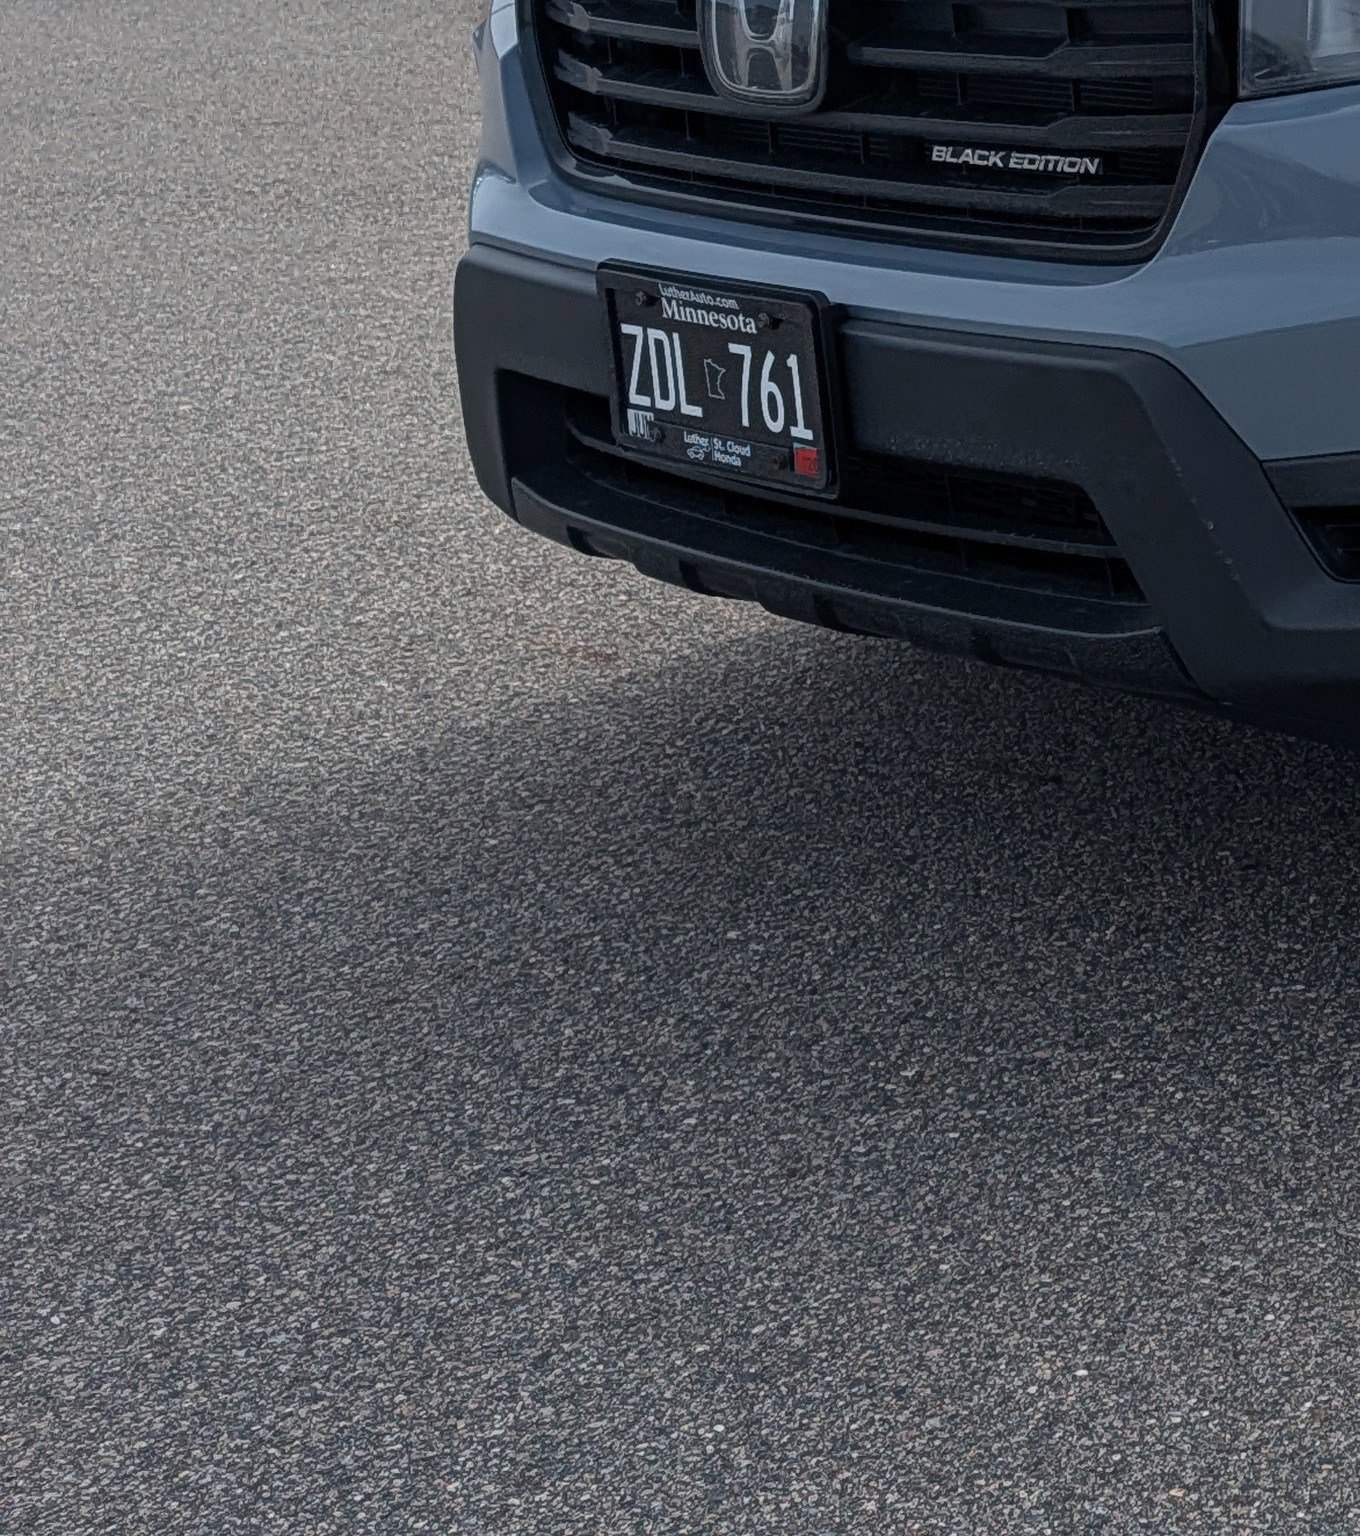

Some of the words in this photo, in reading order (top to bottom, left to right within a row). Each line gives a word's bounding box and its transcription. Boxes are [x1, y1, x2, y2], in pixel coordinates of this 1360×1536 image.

[931, 145, 1006, 168] BLACK
[1008, 151, 1100, 174] EDITION
[661, 297, 757, 334] Minnesota
[620, 323, 703, 418] ZDL
[728, 343, 814, 440] 761
[714, 450, 742, 466] Honda
